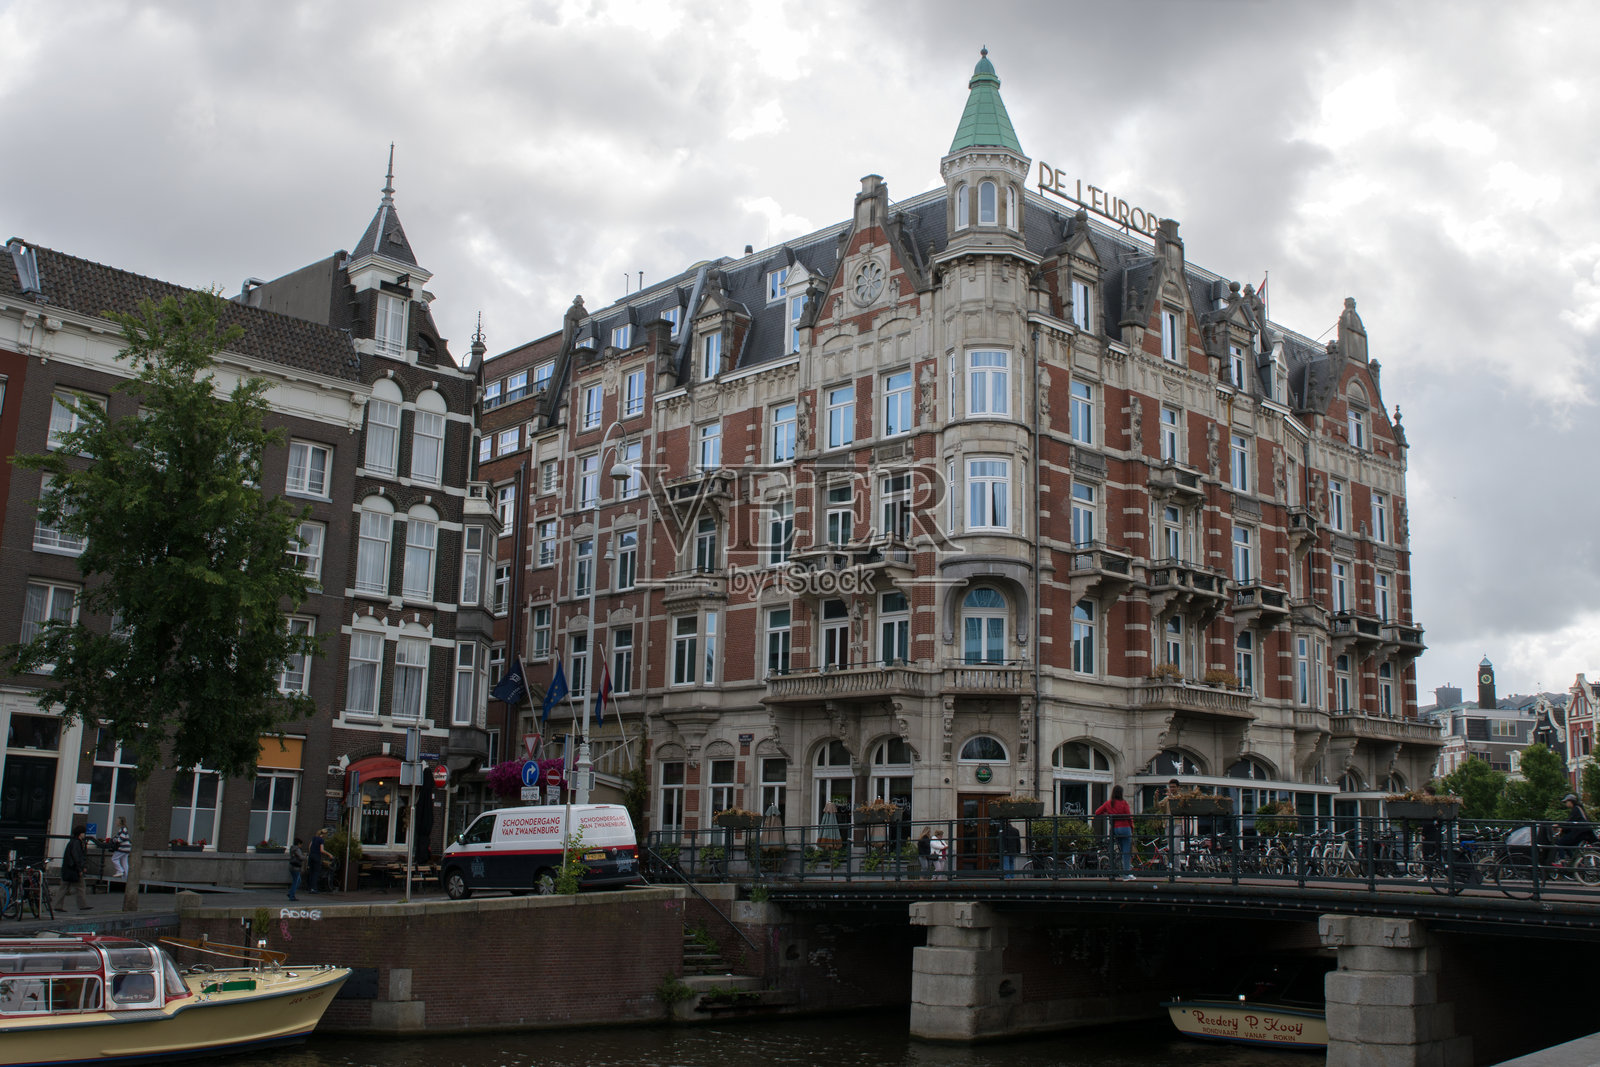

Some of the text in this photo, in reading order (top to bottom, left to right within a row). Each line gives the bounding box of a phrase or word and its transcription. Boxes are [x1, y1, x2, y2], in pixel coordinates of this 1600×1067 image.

[1039, 161, 1161, 234] DE L'EUROP
[503, 817, 560, 827] SCHOONDERGANG
[501, 825, 560, 836] VAN ZWANENBURG
